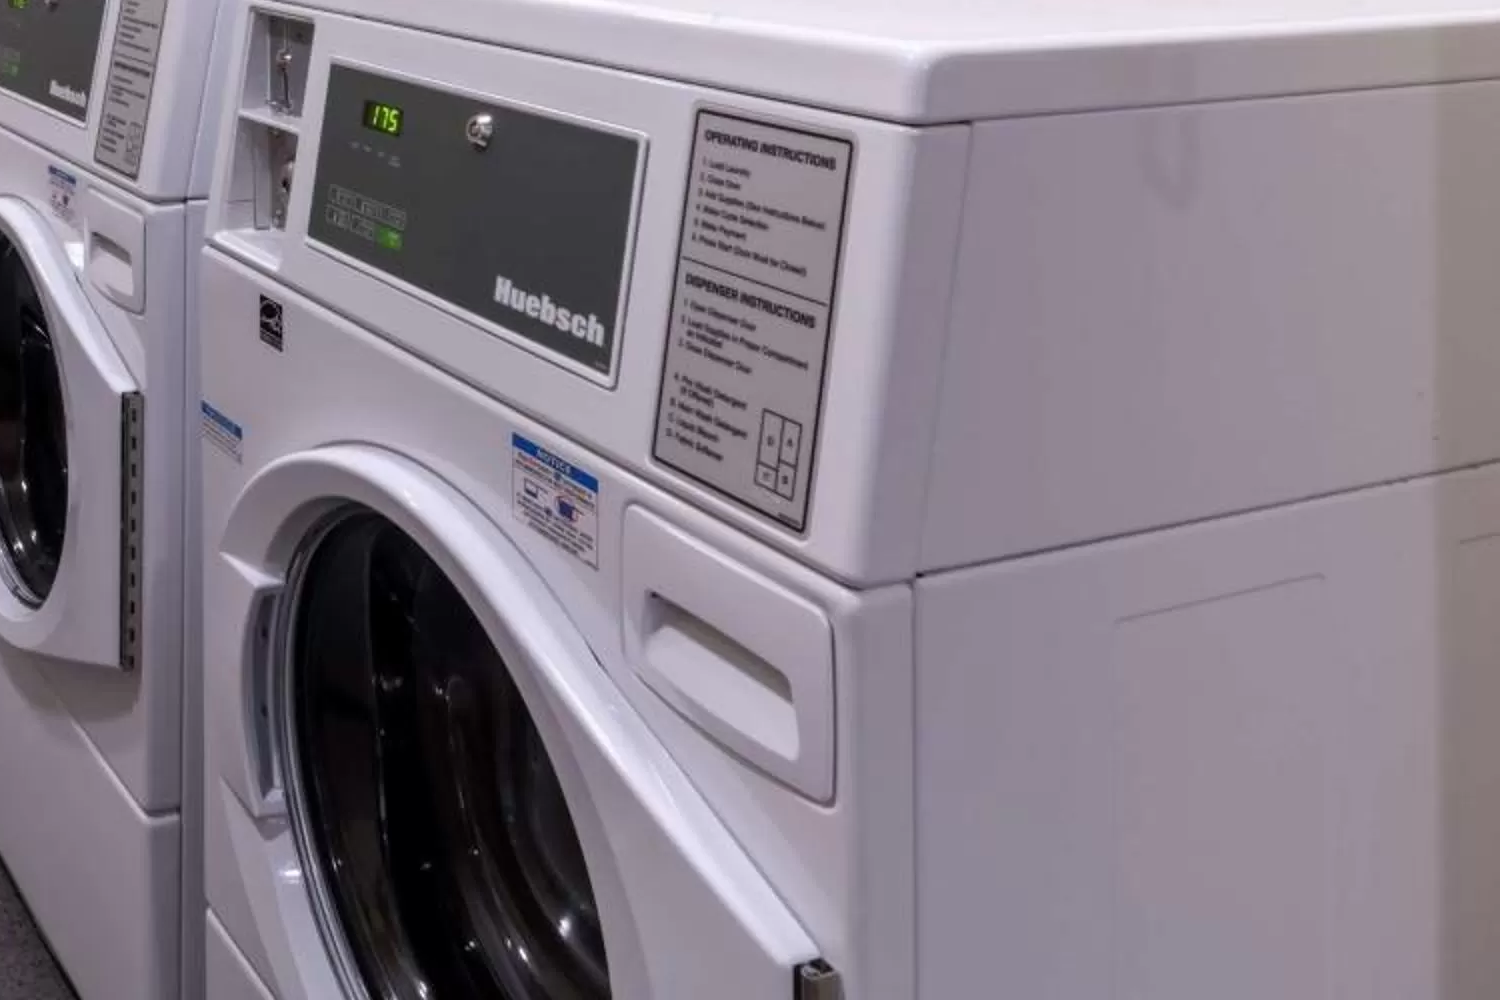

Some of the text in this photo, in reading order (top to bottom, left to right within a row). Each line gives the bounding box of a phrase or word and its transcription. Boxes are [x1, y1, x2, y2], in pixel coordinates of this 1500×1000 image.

[704, 129, 759, 153] OPERATING
[759, 143, 837, 171] INSTRUCTIONS
[493, 273, 606, 348] Huebsch
[684, 273, 739, 300] DISPENSER
[739, 292, 817, 329] INSTRUCTIONS
